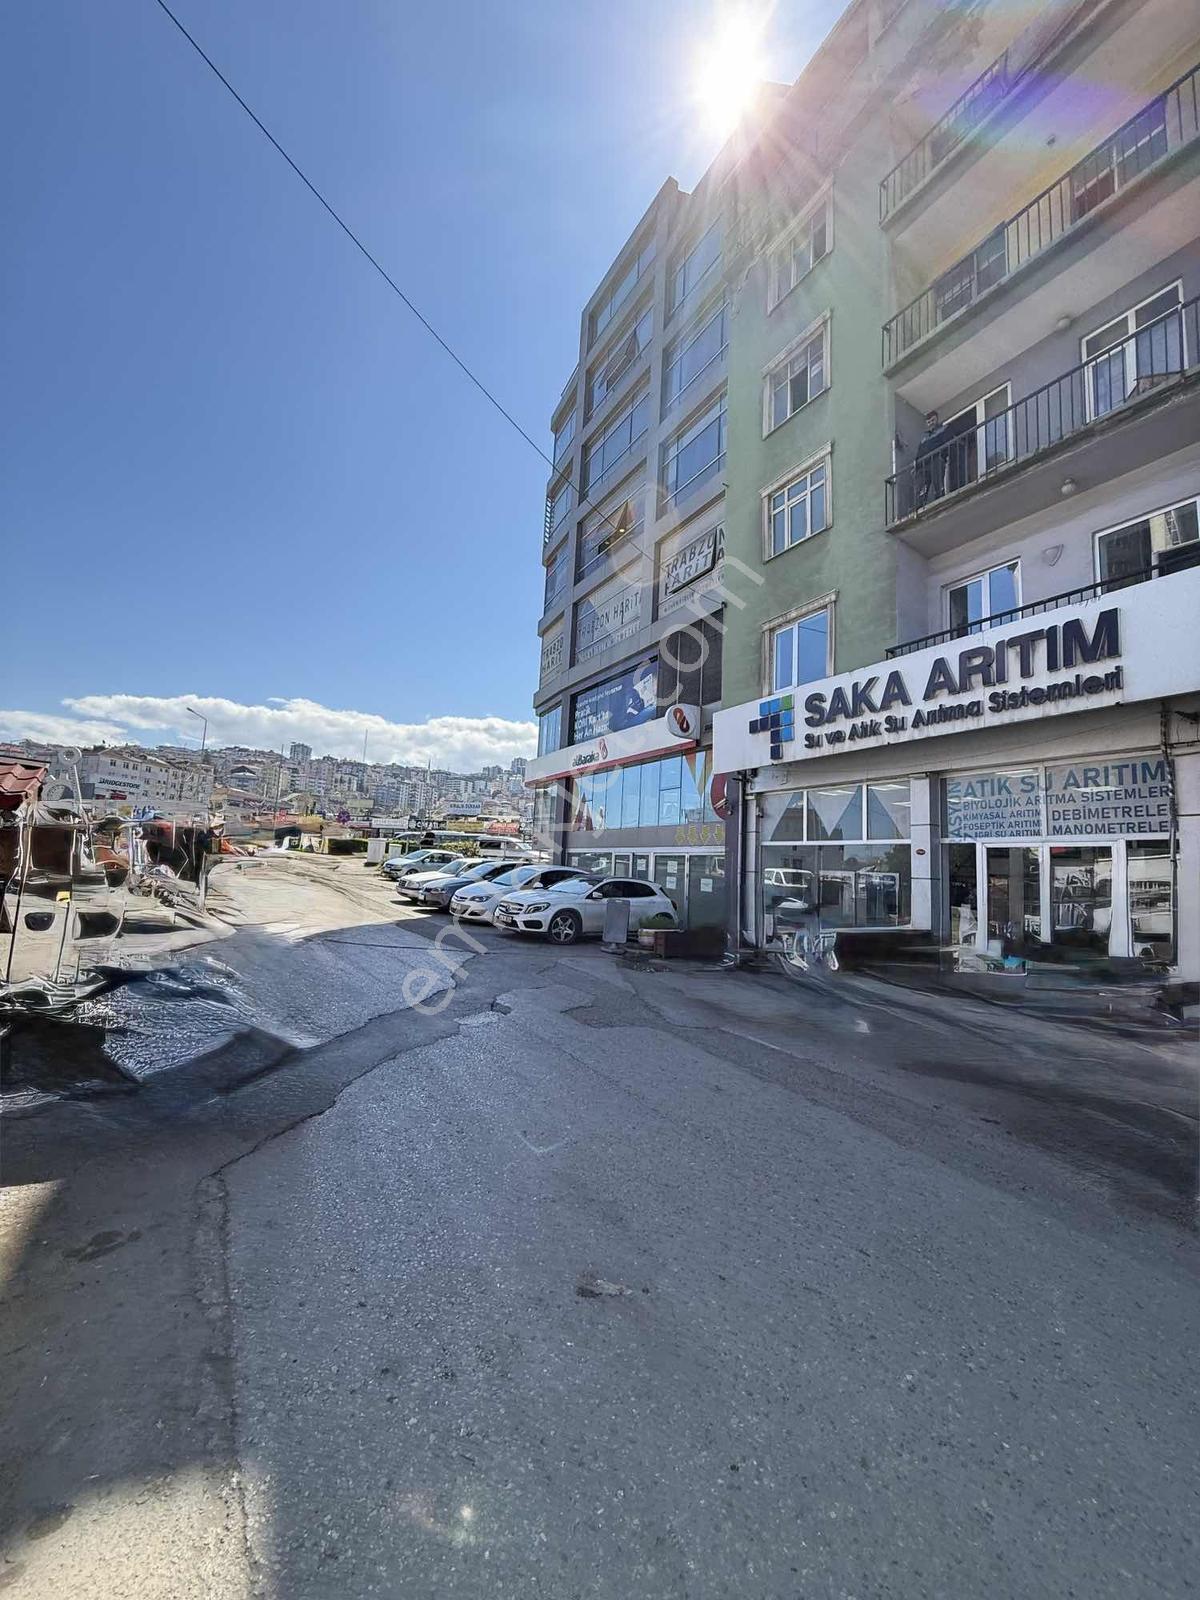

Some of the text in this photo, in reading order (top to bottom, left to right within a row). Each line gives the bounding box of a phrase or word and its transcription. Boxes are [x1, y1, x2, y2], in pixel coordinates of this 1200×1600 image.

[804, 606, 1121, 729] SAKA ARITIM
[825, 730, 846, 745] ve
[884, 714, 908, 735] Su
[989, 665, 1123, 713] Sistemleri
[963, 759, 1166, 798] ATIK SU ARITIM
